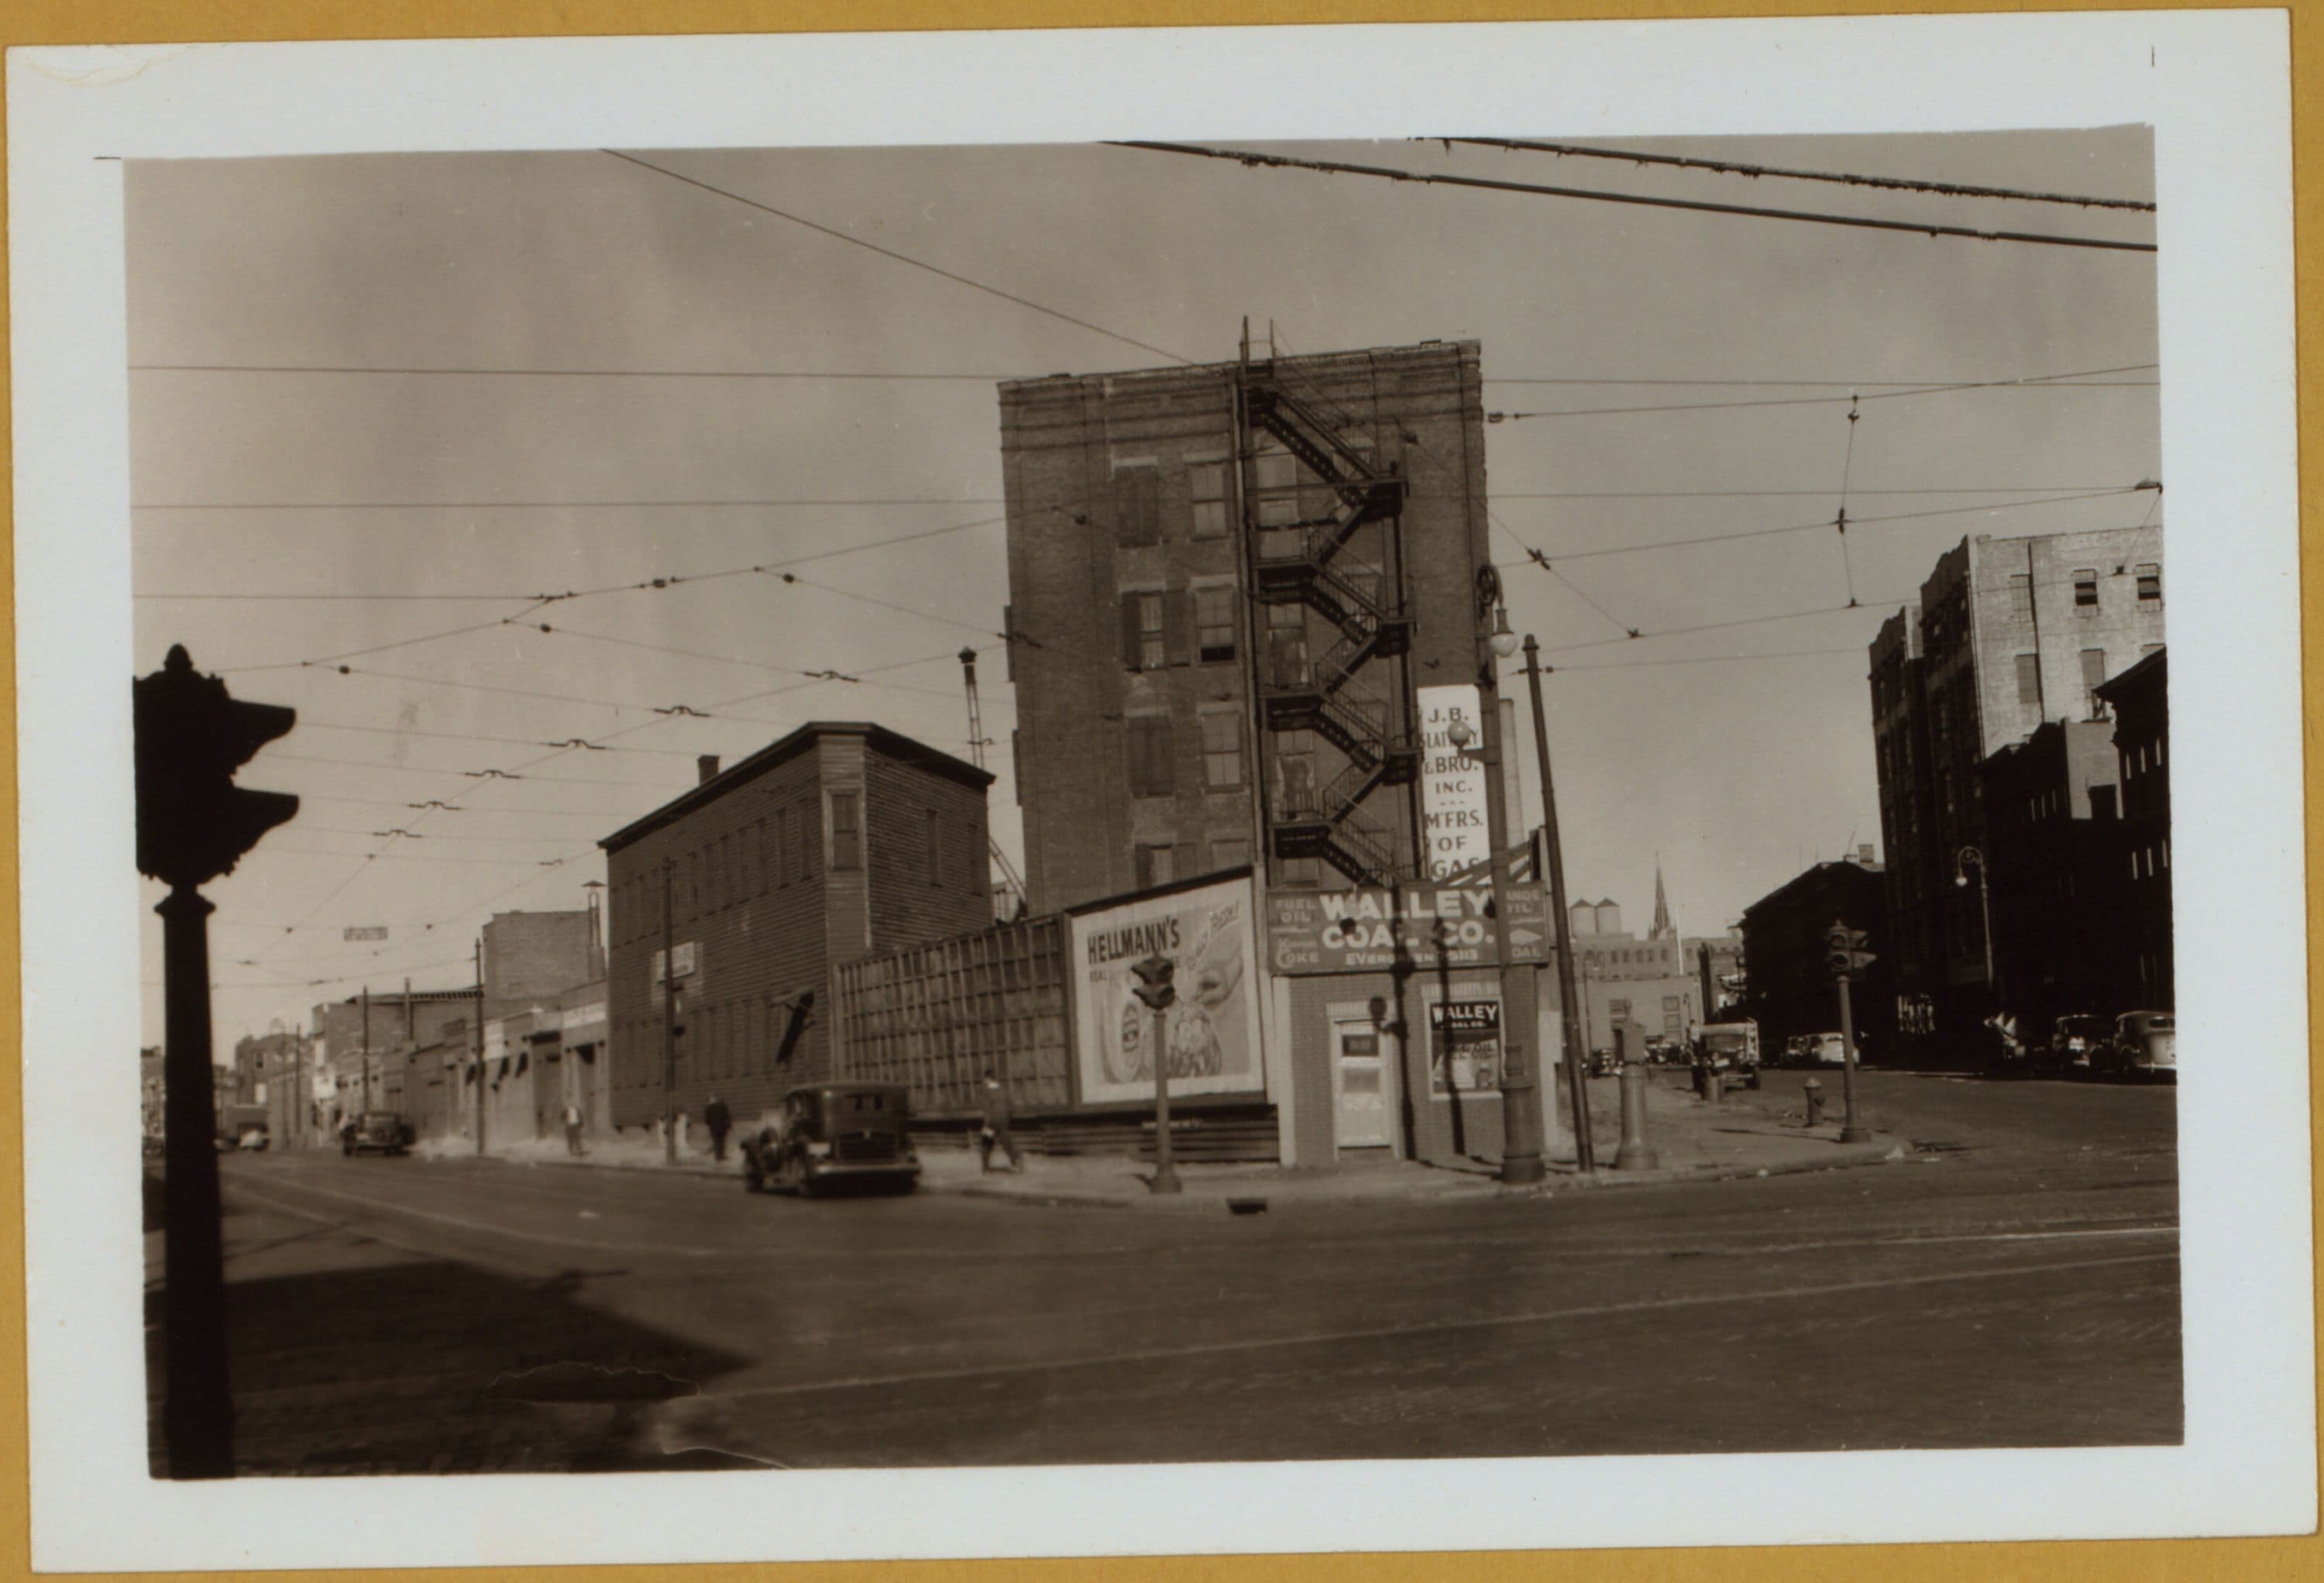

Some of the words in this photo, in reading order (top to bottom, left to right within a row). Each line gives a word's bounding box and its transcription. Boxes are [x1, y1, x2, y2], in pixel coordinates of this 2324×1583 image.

[1428, 707, 1469, 723] J.B.
[1420, 730, 1478, 748] SLATY
[1435, 781, 1472, 794] INC.
[1438, 835, 1469, 852] OF
[1506, 889, 1540, 900] ANGE
[1275, 899, 1315, 911] FUEL
[1319, 890, 1491, 920] WALLEY
[1281, 910, 1311, 923] OIL
[1088, 914, 1181, 965] HELLMANN'S
[1346, 952, 1435, 966] EVERGEN
[1511, 946, 1542, 958] OAL
[1432, 1005, 1497, 1024] WALLEY
